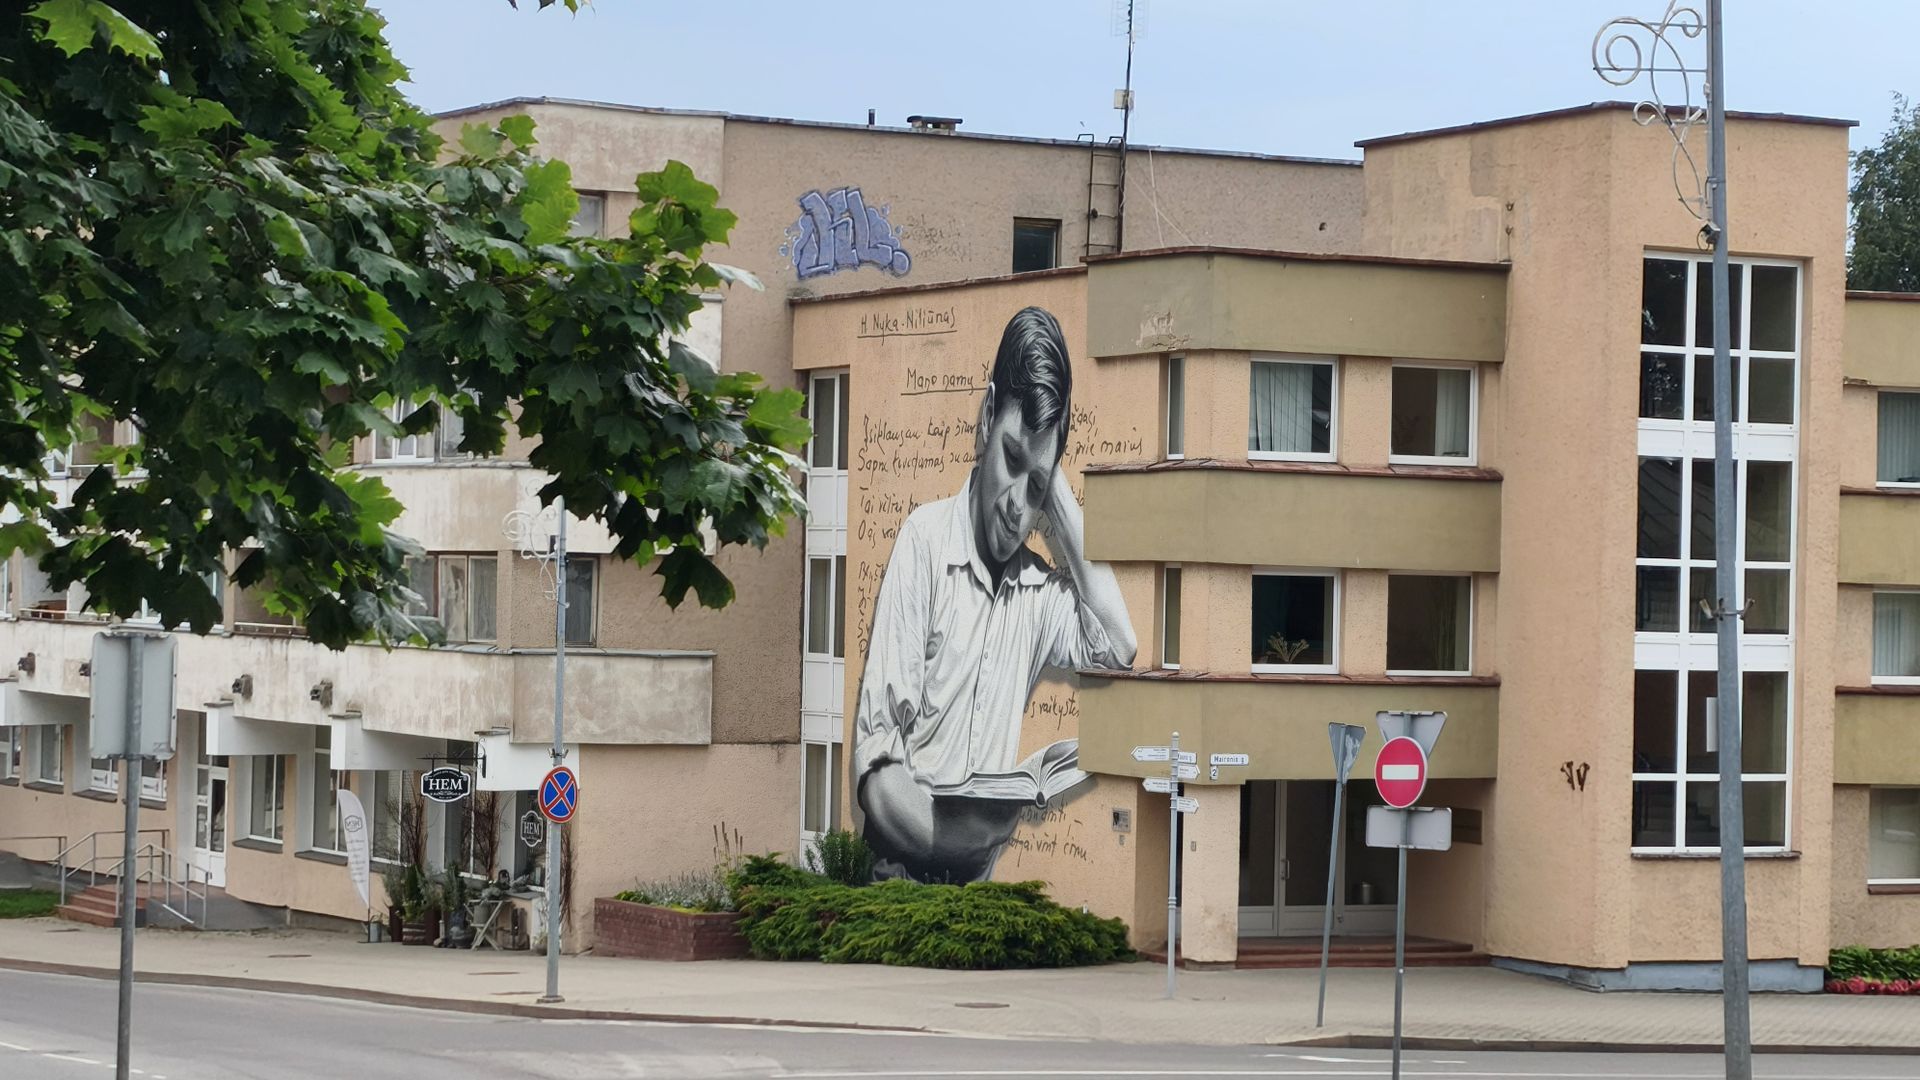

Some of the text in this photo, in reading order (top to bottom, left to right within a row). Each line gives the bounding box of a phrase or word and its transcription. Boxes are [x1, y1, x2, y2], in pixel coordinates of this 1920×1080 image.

[906, 367, 938, 392] Mano
[1212, 768, 1217, 777] 2
[428, 778, 463, 791] HEM
[523, 821, 540, 836] HEM
